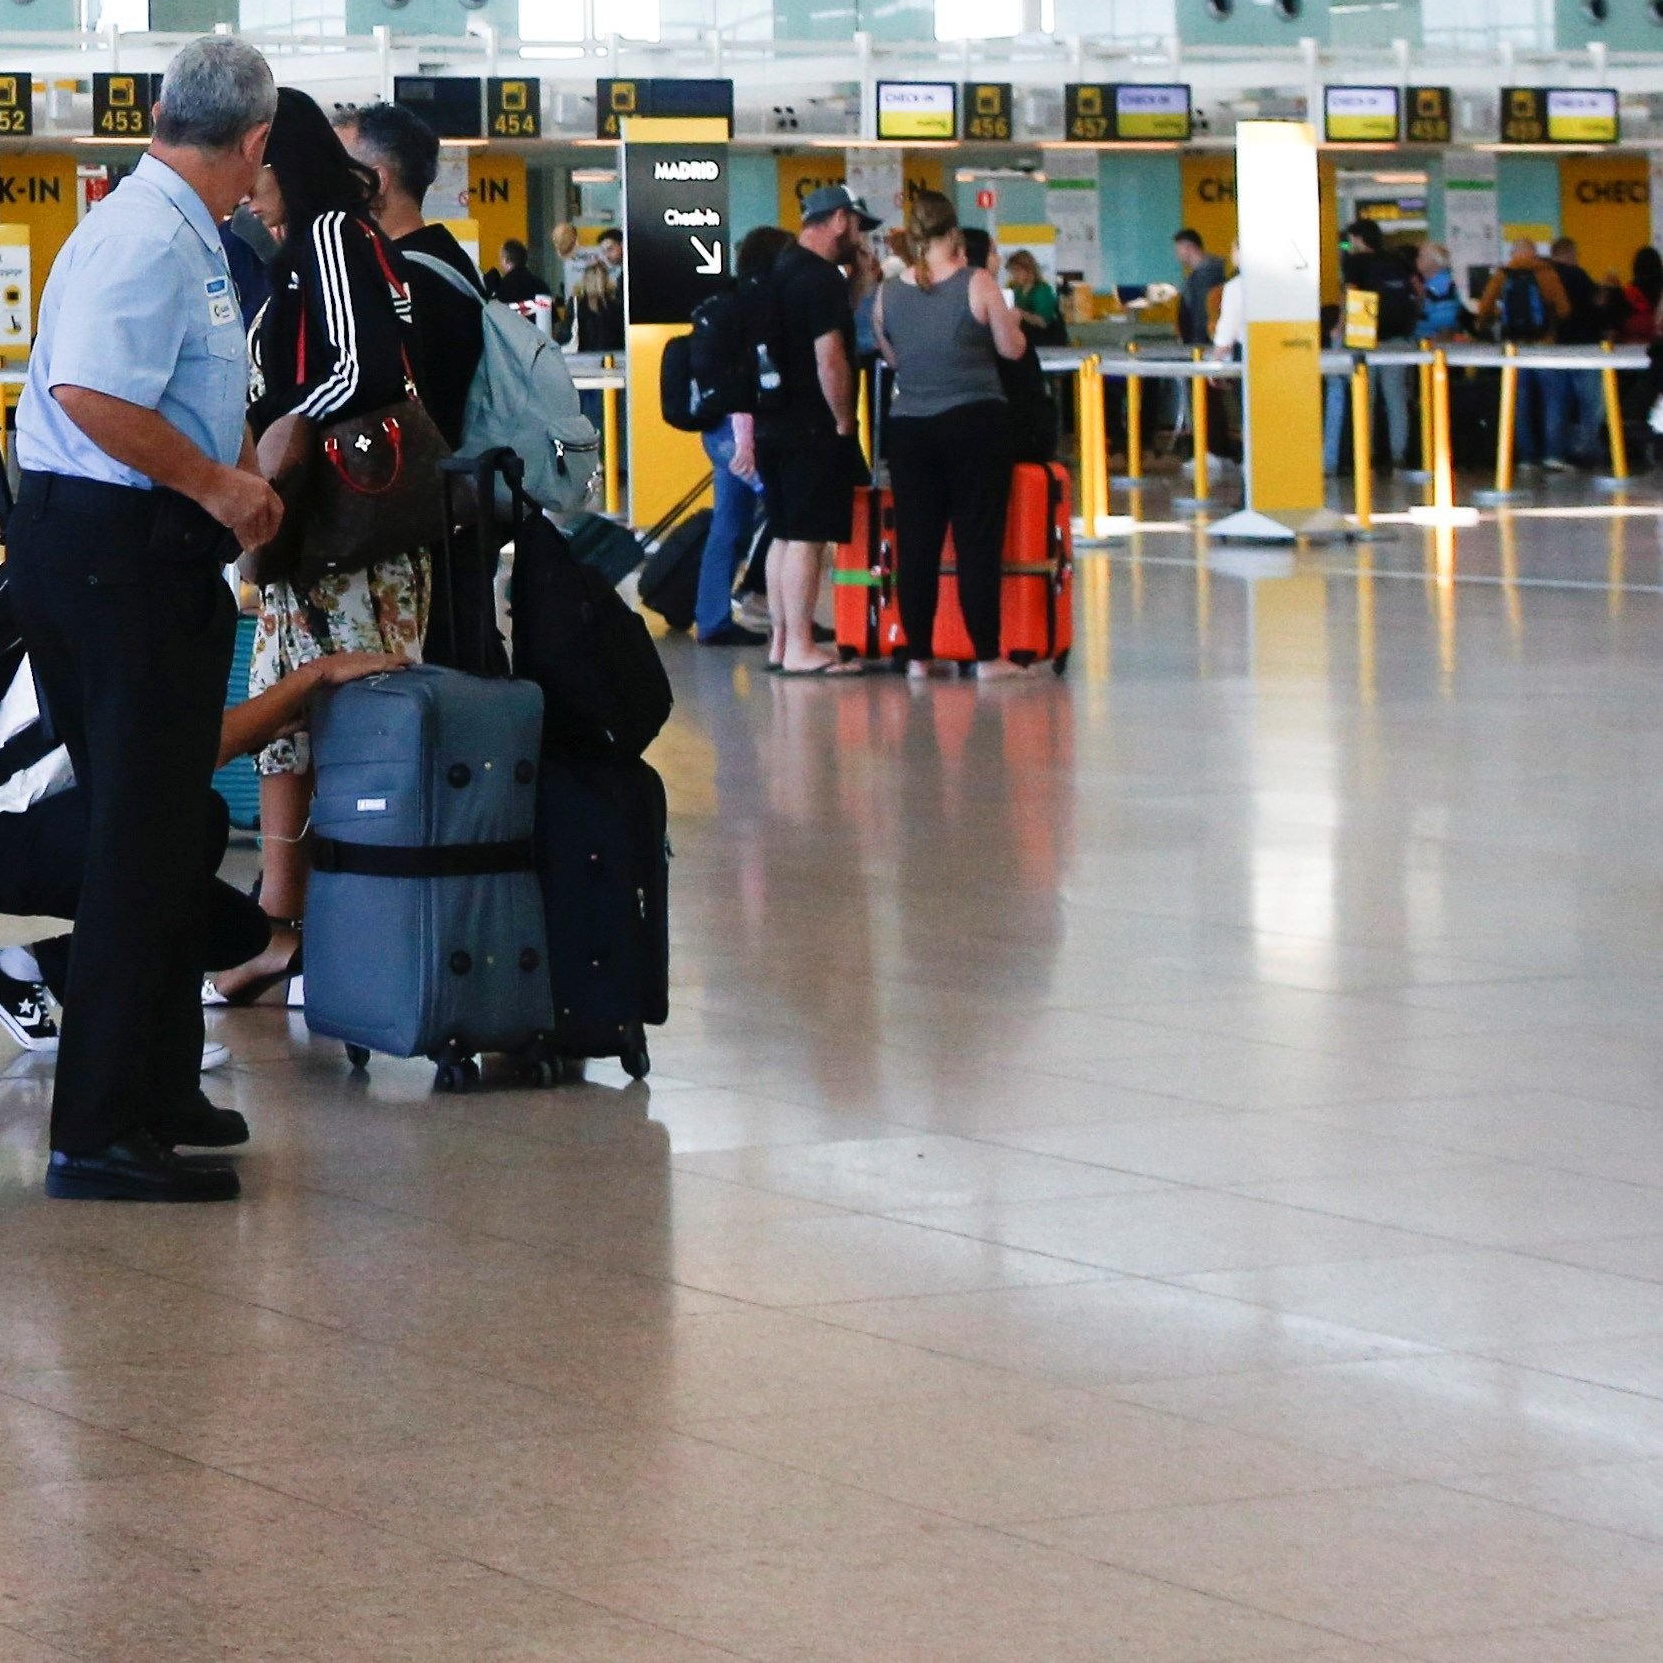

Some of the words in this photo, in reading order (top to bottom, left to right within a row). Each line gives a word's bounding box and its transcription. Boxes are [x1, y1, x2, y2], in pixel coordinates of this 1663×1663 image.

[101, 110, 144, 132] 453
[494, 115, 534, 135] 454
[654, 160, 719, 181] MADRID
